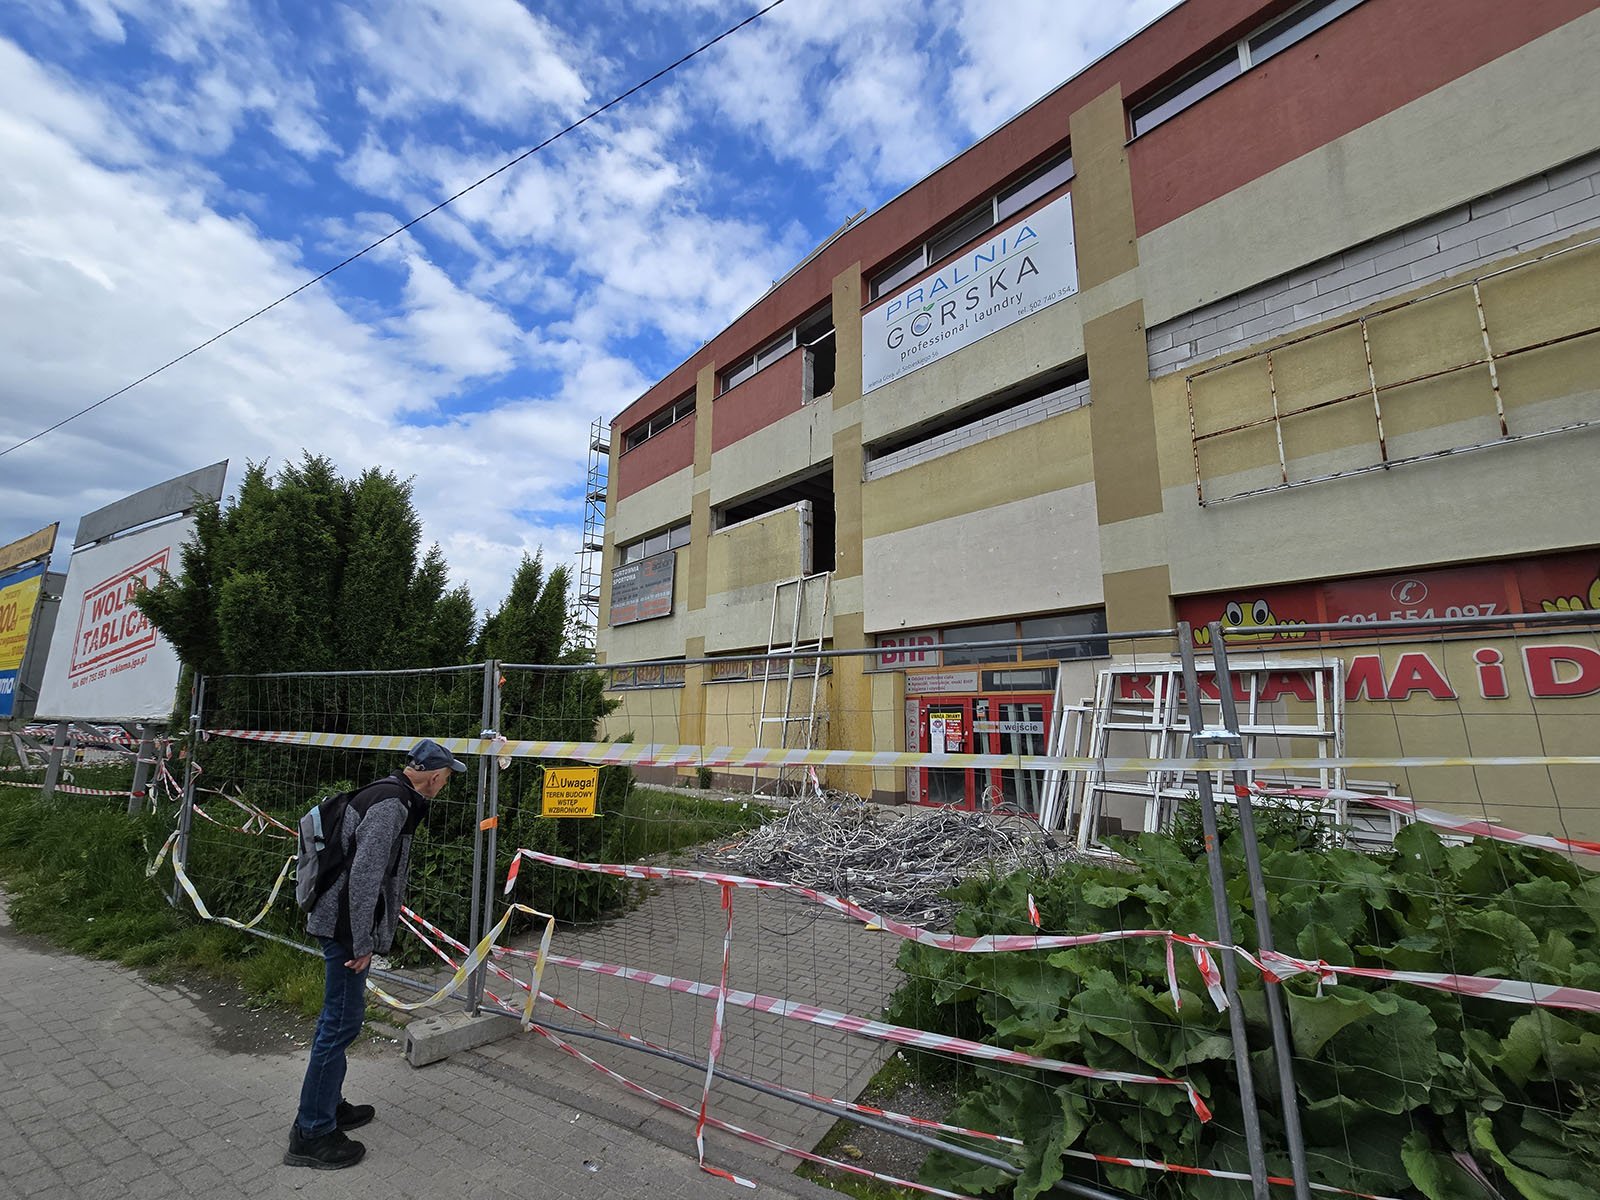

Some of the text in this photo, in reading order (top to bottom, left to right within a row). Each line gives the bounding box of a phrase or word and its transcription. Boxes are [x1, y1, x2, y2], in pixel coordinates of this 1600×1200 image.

[886, 225, 1038, 321] PRALNIA
[1029, 300, 1042, 310] 502
[1044, 292, 1056, 303] 740
[1058, 286, 1071, 297] 354
[900, 291, 1023, 361] professional laundry
[82, 610, 149, 656] TABLICA
[881, 635, 934, 664] BHP
[1473, 647, 1509, 699] i
[1004, 722, 1039, 733] wejście
[546, 790, 594, 799] TEREN BUDOWY
[560, 777, 595, 790] Uwaga!
